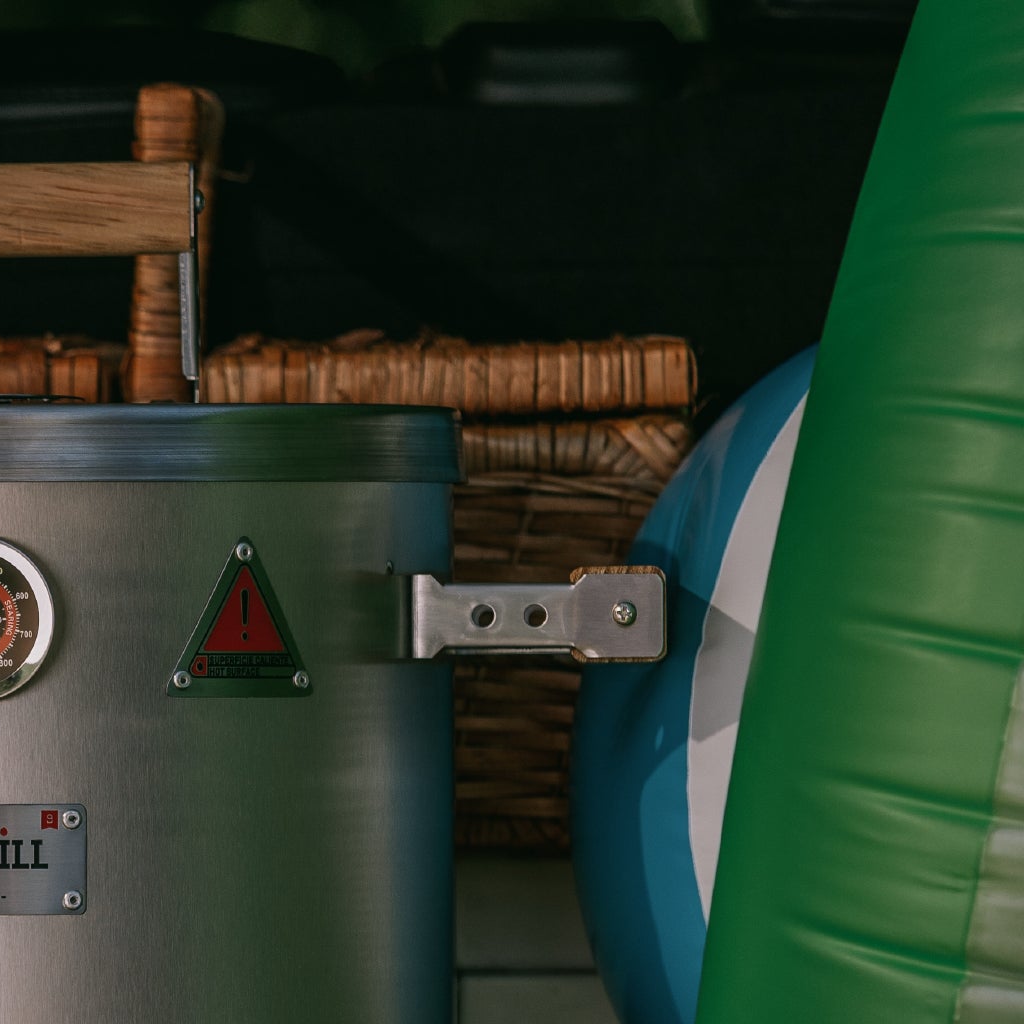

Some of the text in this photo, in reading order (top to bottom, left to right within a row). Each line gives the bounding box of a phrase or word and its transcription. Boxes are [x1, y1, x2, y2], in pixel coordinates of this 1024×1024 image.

[4, 599, 14, 636] SEARING
[20, 630, 32, 638] 700
[209, 667, 225, 677] HOT
